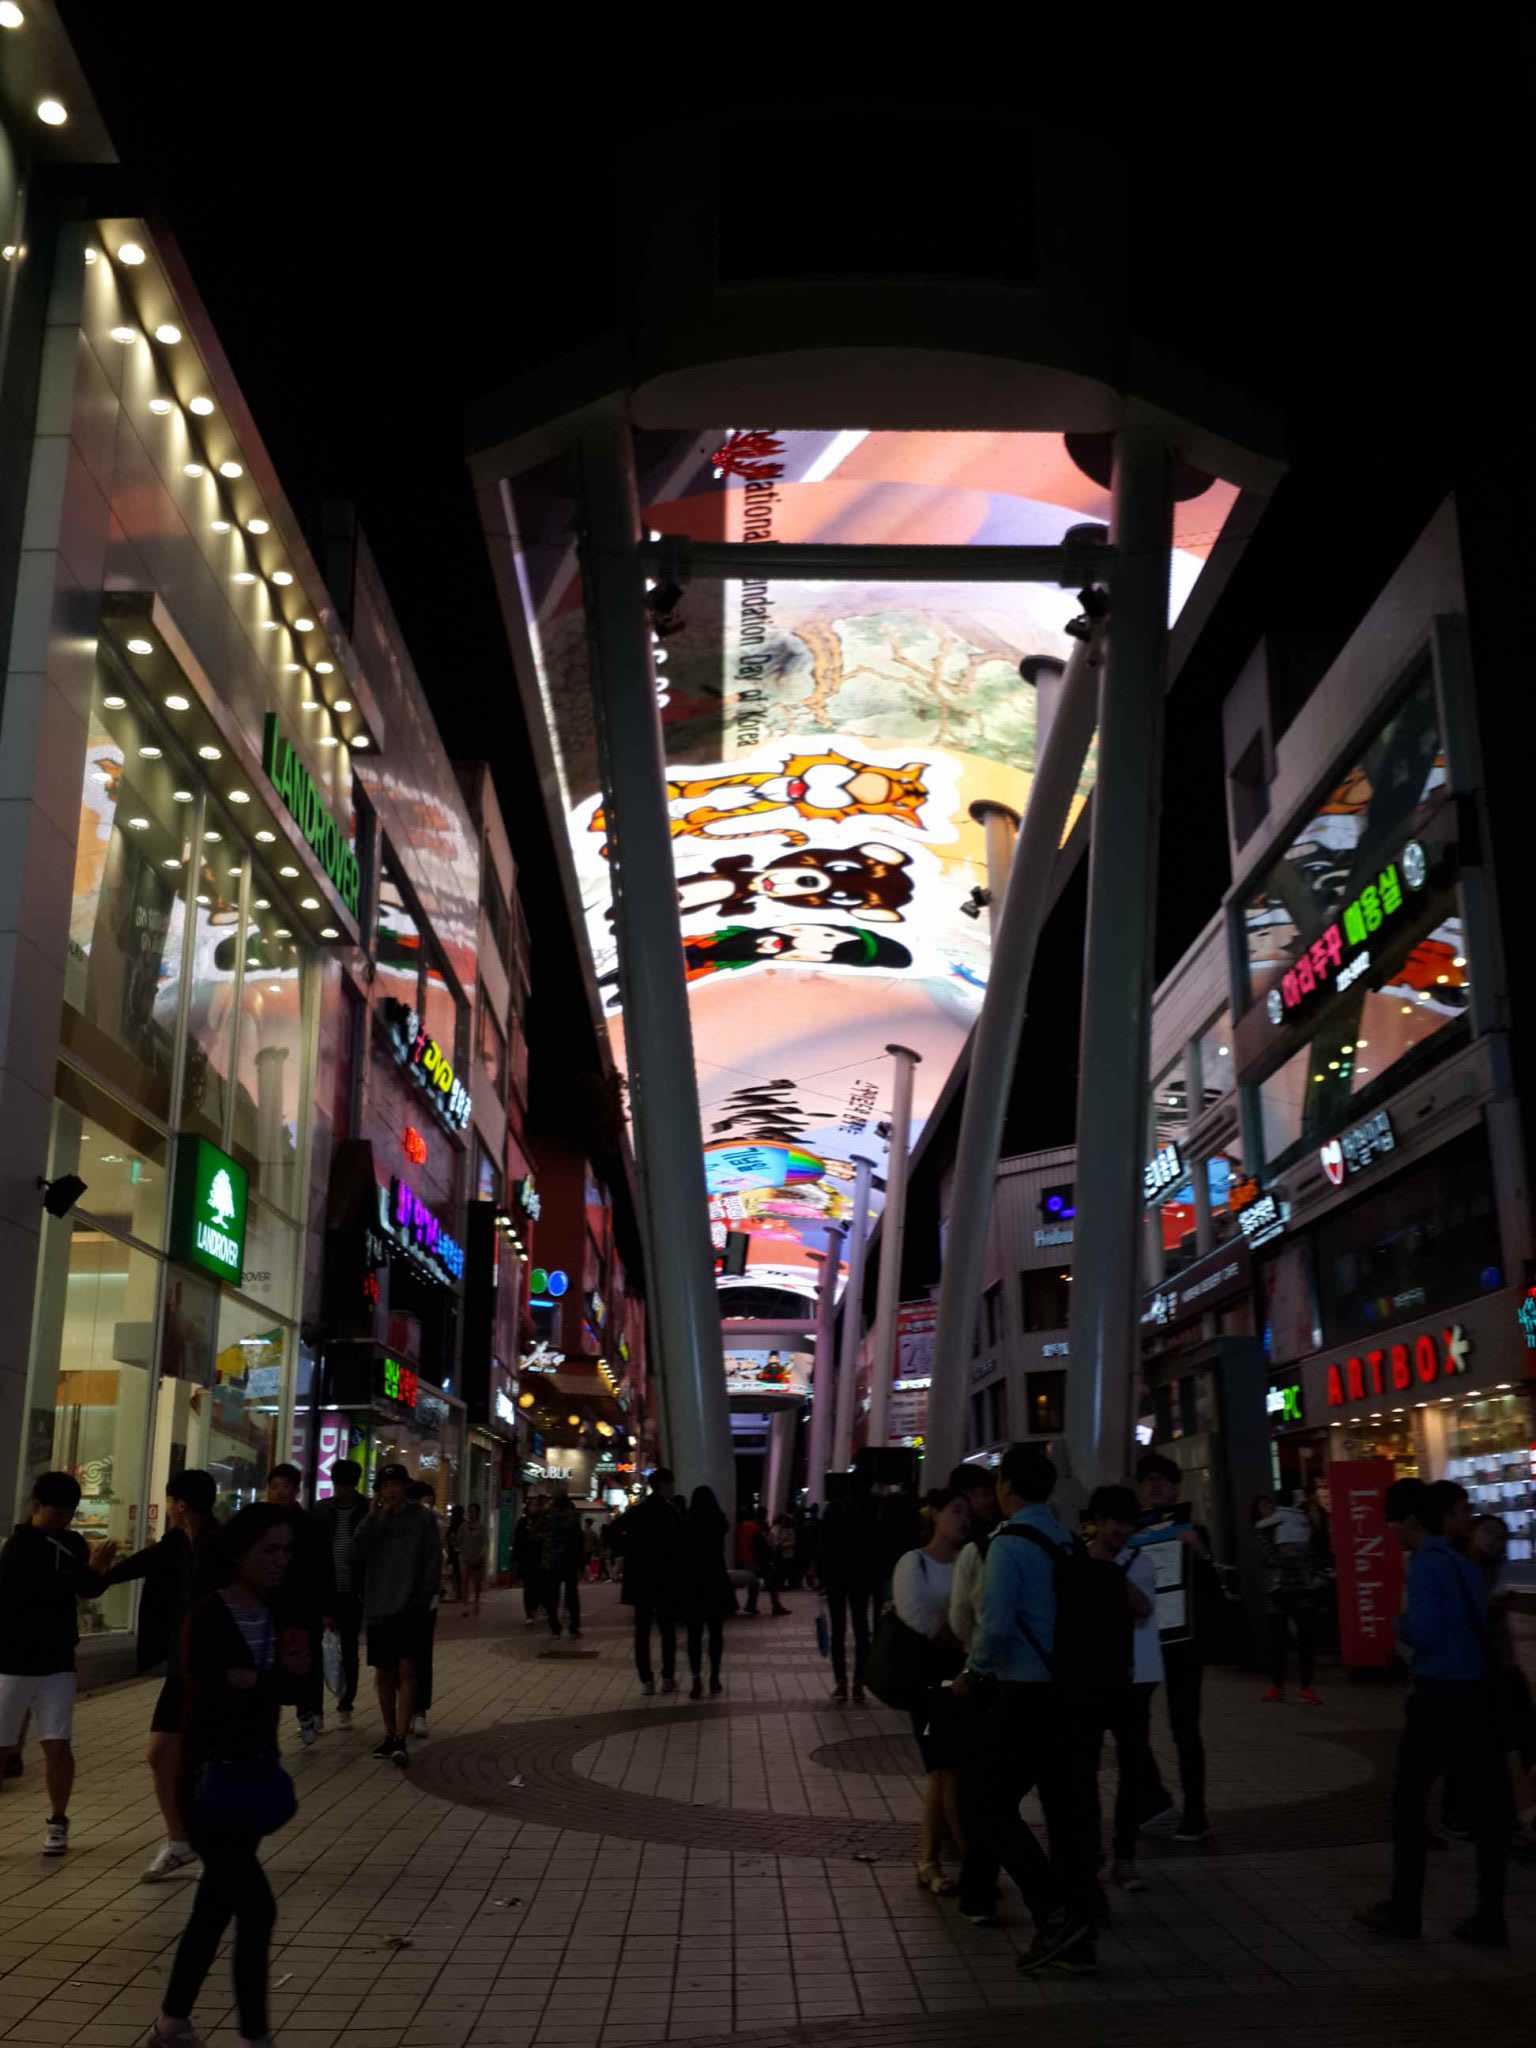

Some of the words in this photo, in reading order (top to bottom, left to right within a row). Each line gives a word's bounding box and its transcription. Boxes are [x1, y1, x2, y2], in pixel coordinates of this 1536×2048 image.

[738, 579, 776, 647] undation
[734, 654, 773, 681] Day
[739, 690, 769, 702] of
[737, 707, 768, 748] Korea
[265, 712, 361, 922] LANDROVER
[197, 1220, 239, 1268] LANDROVER
[241, 1271, 272, 1282] ROVER
[1327, 1325, 1471, 1408] ARTBOX
